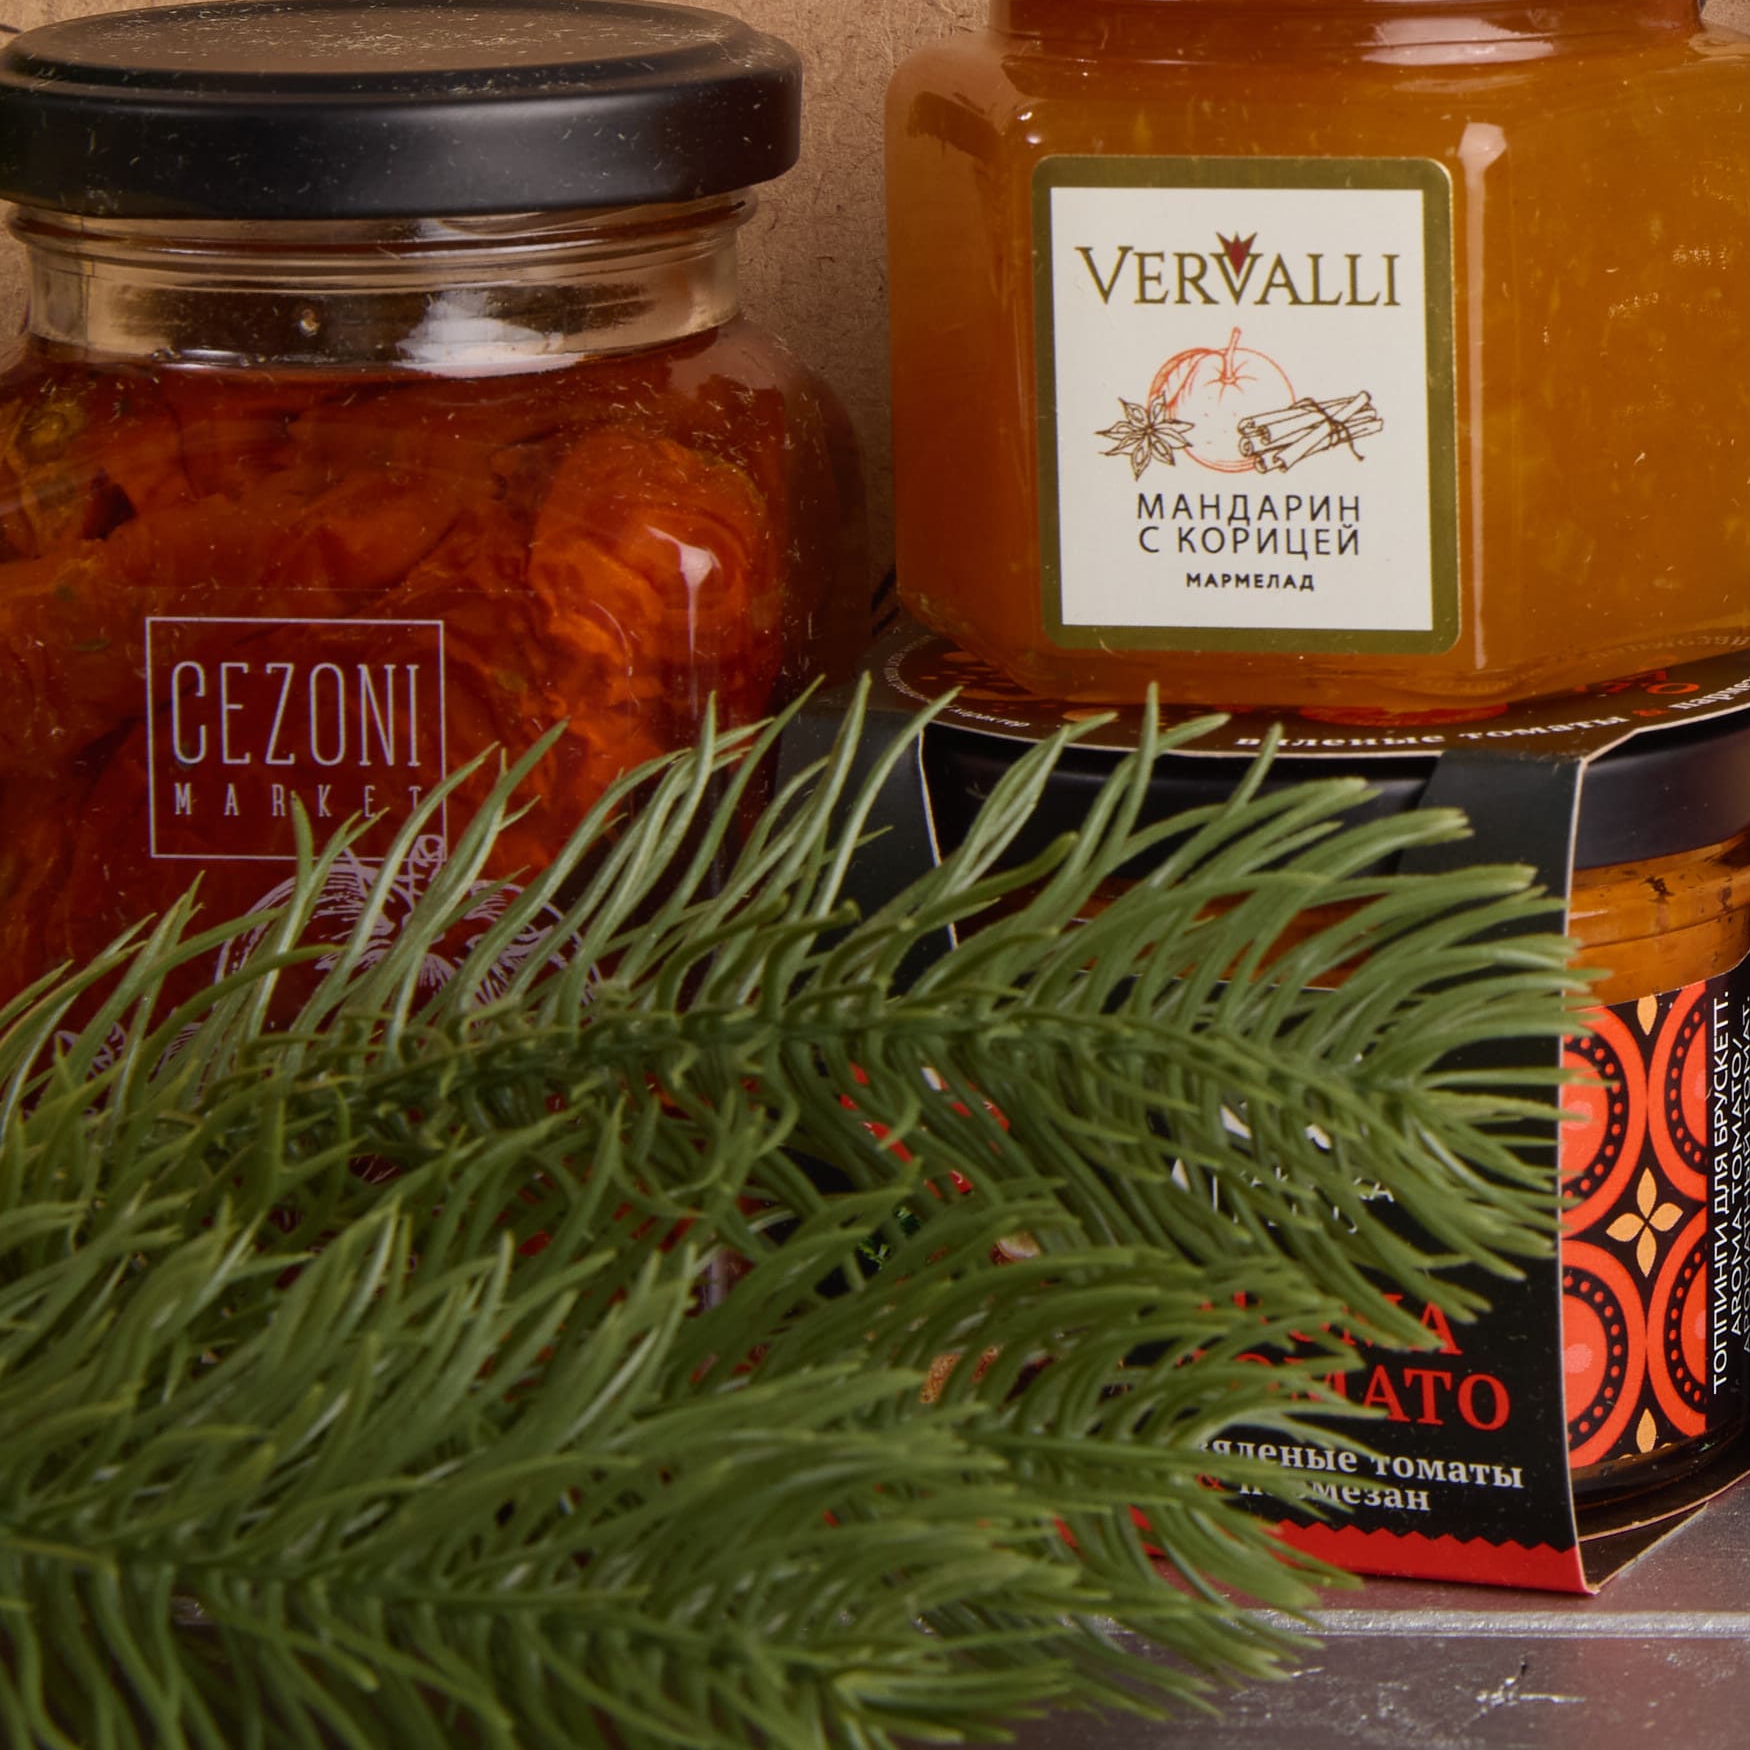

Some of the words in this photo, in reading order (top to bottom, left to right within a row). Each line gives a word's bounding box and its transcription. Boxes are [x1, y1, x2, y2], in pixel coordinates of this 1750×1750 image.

[1074, 245, 1401, 306] VERVALLI
[1136, 492, 1360, 527] МАНДАРИН
[1138, 525, 1161, 554] С
[1177, 523, 1360, 560] КОРИЦЕЙ
[1185, 572, 1315, 592] МАРМЕЛАД
[171, 660, 421, 767] CEZONI
[1458, 715, 1631, 740] томаты
[174, 782, 423, 818] MARKET
[1713, 990, 1729, 1148] БРУСКЕТТ.
[1742, 995, 1750, 1124] ТОМАТ.
[1713, 1152, 1730, 1215] ДЛЯ
[1742, 1126, 1750, 1353] АРОМАТНЫЙ
[1730, 1207, 1743, 1336] AROMA
[1713, 1221, 1728, 1395] ТОППИНГИ
[1370, 1453, 1524, 1489] томаты
